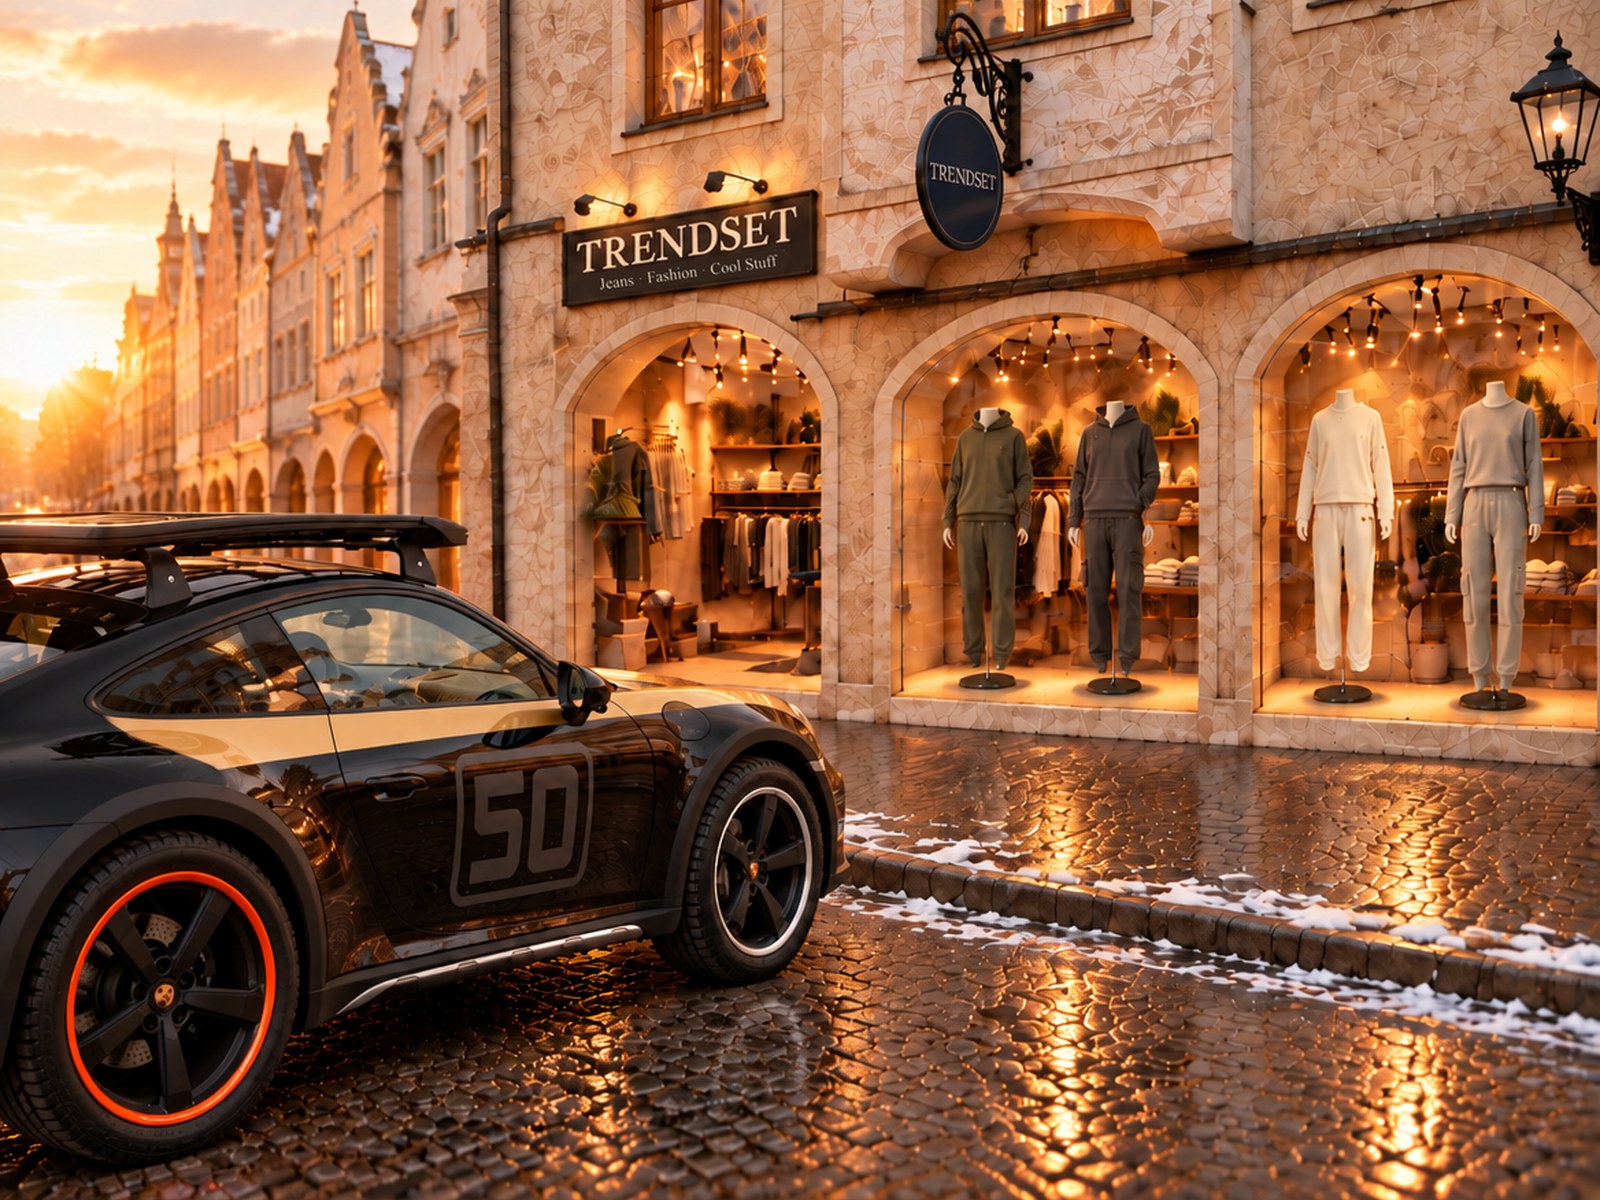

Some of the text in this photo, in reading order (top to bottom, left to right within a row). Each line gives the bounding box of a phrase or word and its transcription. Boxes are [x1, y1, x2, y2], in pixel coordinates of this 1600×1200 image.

[929, 162, 997, 191] TRENDSET
[576, 206, 798, 273] TRENDSET
[599, 254, 778, 290] Jeans Fashion Cool Stuff
[469, 764, 579, 885] 50
